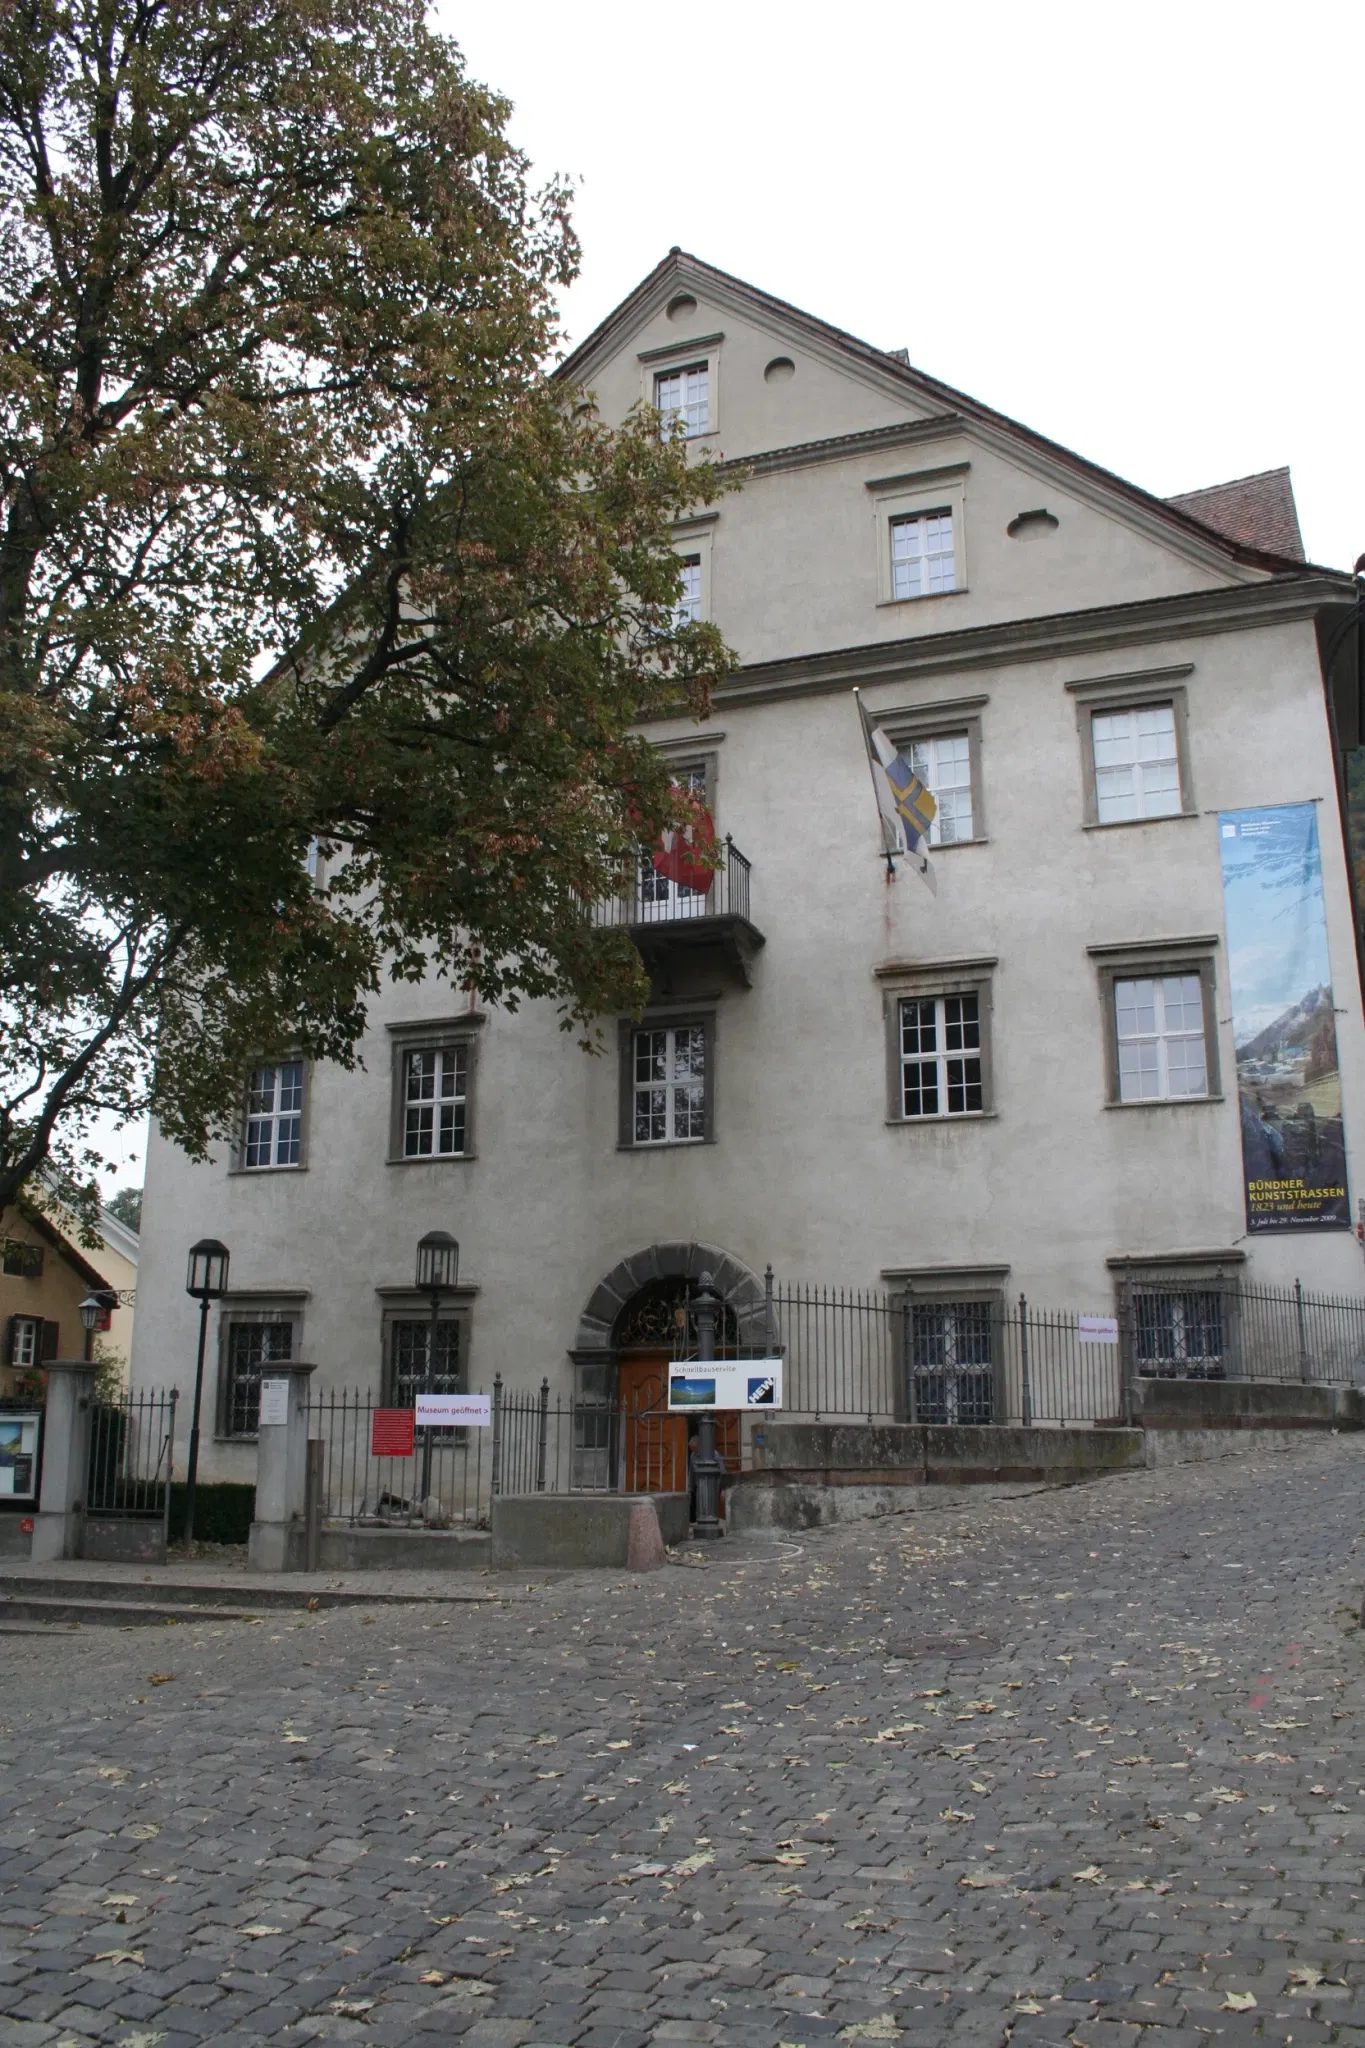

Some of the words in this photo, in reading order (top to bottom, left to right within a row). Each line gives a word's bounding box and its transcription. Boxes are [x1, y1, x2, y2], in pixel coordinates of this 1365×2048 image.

[1248, 1180, 1304, 1191] BÜNDNER
[1249, 1187, 1345, 1202] KUNSTSTRASSEN
[1251, 1202, 1274, 1212] 1823
[1276, 1200, 1295, 1211] und
[1297, 1199, 1322, 1210] heute
[1290, 1215, 1320, 1224] November
[1320, 1214, 1337, 1222] 2009
[749, 1377, 774, 1404] HEW
[417, 1406, 449, 1414] Museum
[451, 1406, 482, 1415] geöffnet
